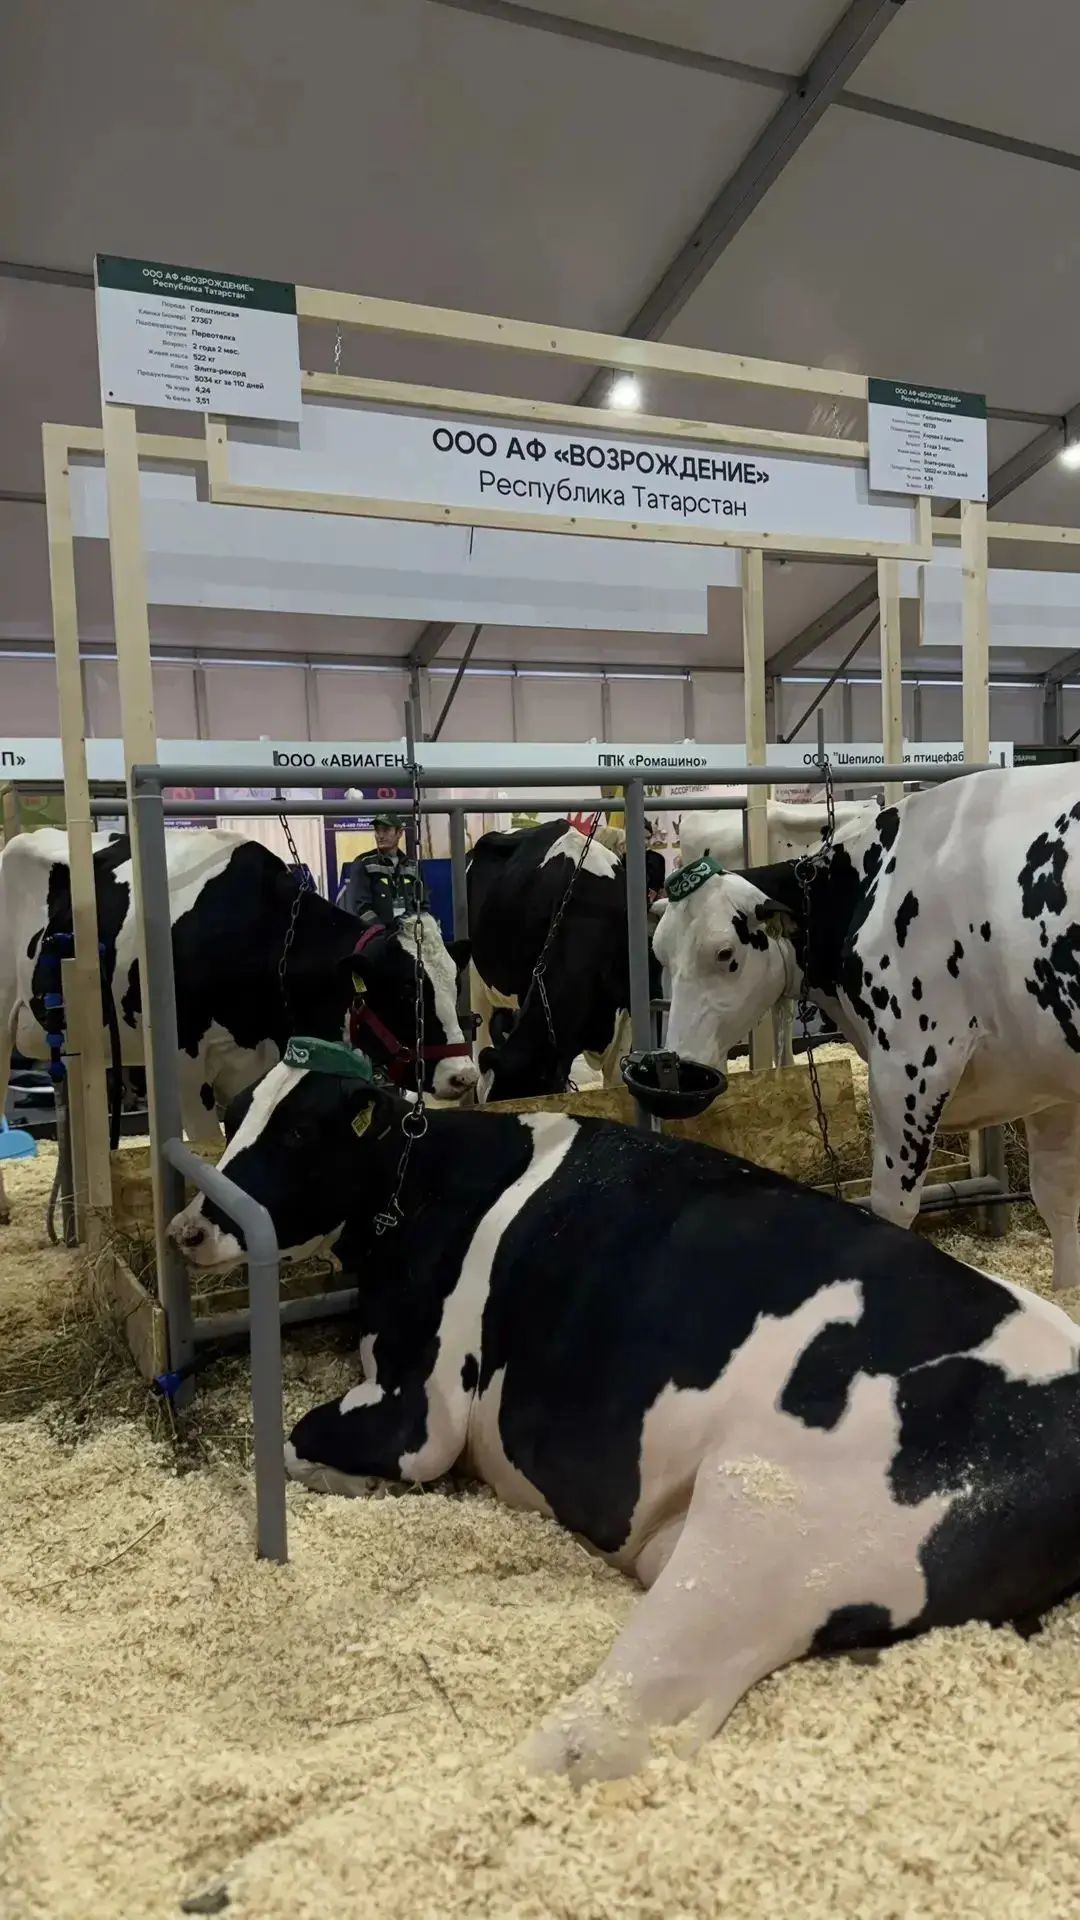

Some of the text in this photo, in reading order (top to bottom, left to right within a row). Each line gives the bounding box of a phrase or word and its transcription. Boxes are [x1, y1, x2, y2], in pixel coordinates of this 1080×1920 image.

[142, 269, 254, 292] ООО АФ «ВОЗРОЖДЕНИЕ»
[153, 279, 245, 299] Республика Татарстан
[190, 306, 239, 317] Голштинская
[191, 316, 212, 325] 27367
[192, 330, 235, 341] Первотелка
[199, 345, 216, 353] года
[194, 365, 247, 377] Элита-рекорд
[194, 375, 212, 383] 5034
[246, 382, 264, 390] дней
[195, 386, 211, 394] 4,24
[196, 397, 210, 405] 3,51
[901, 396, 956, 408] Республика Татарстан
[432, 427, 770, 485] ООО АФ «ВОЗРОЖДЕНИЕ»
[479, 470, 747, 517] Республика Татарстан
[278, 753, 315, 767] ООО
[628, 755, 707, 767] «Ромашино»
